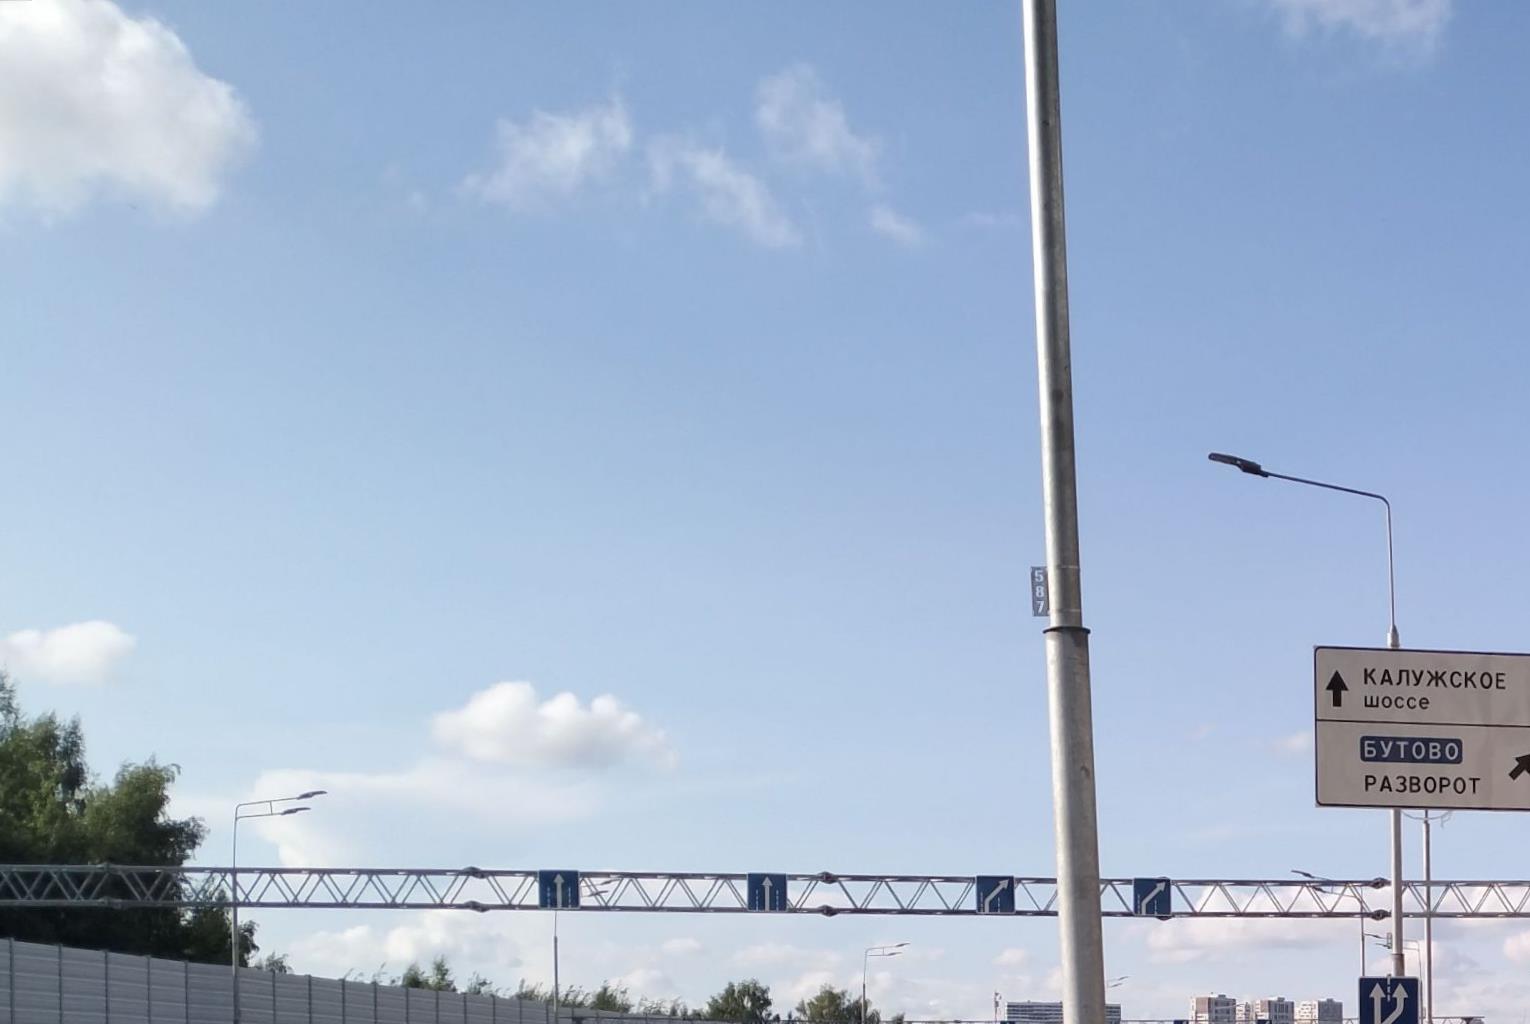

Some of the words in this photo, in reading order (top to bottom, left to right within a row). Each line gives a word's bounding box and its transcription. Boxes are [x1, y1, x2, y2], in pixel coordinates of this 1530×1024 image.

[1363, 668, 1507, 690] КАЛУЖСКОЕ
[1364, 696, 1430, 710] шоссе
[1363, 740, 1460, 761] БУТОВО
[1364, 774, 1481, 795] РАЗВОРОТ
